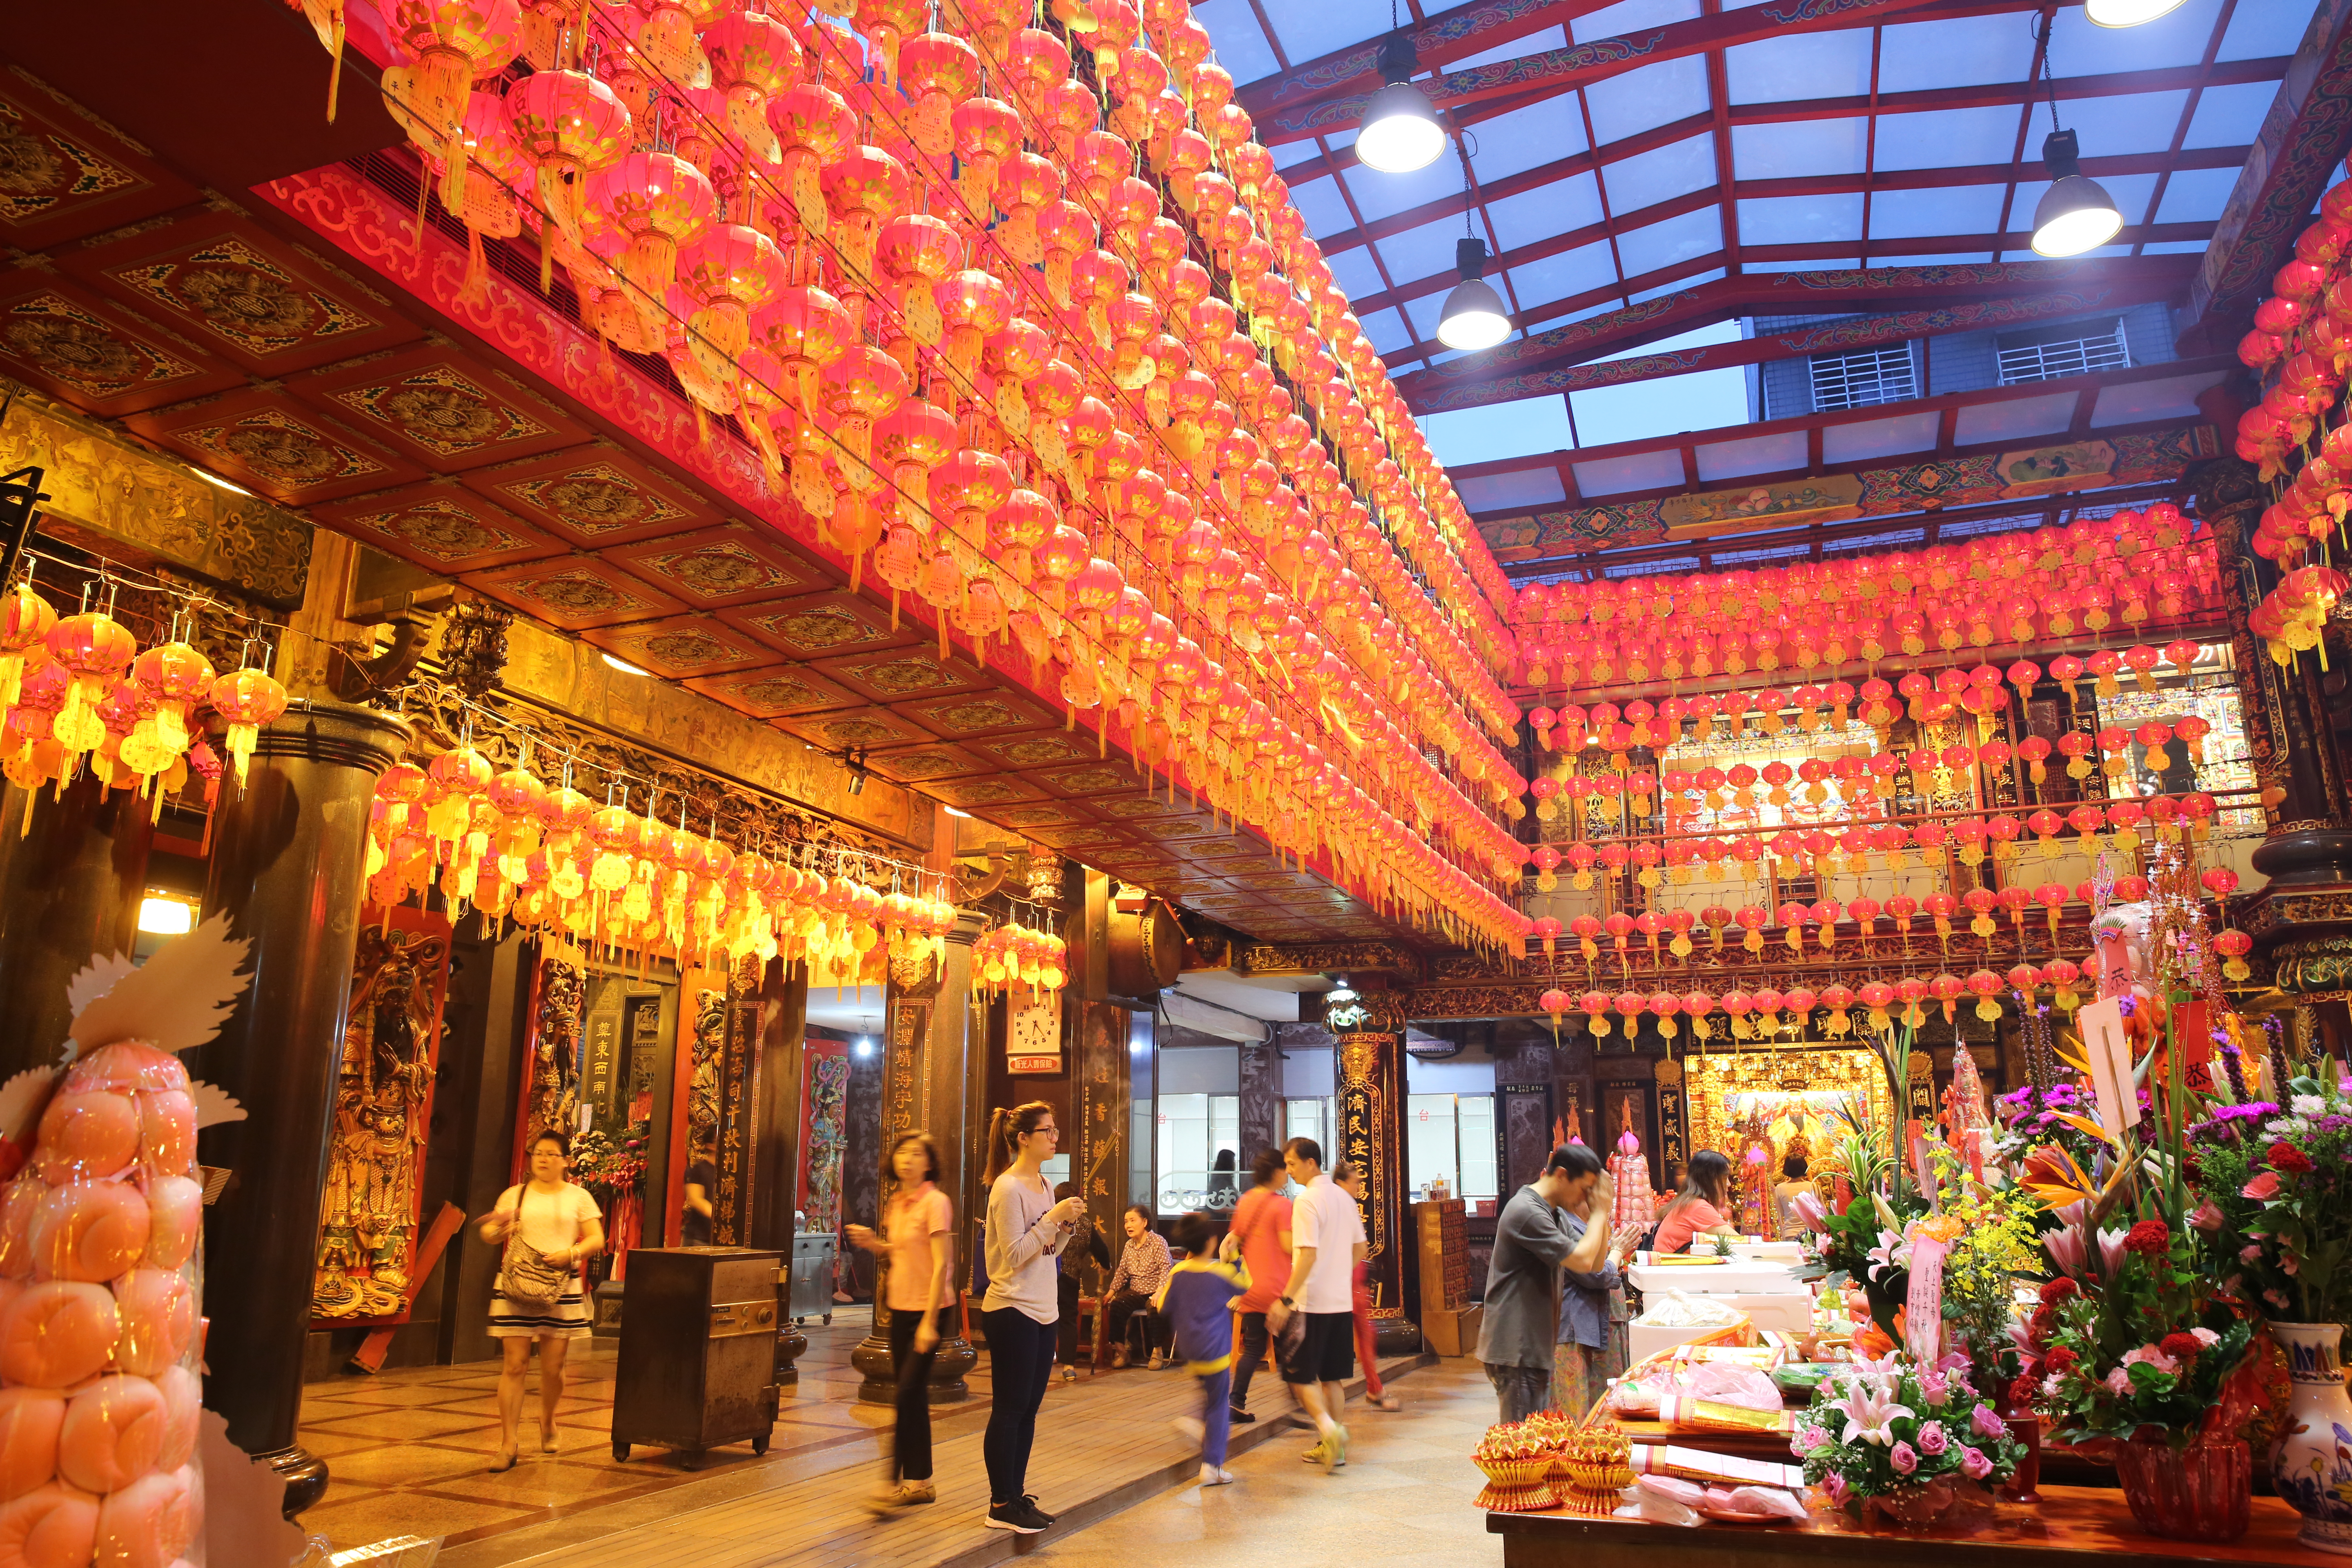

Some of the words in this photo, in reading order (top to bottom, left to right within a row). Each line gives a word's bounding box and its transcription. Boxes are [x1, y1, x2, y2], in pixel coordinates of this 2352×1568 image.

[645, 33, 654, 53] 平安
[731, 109, 739, 127] 平安
[879, 554, 886, 570] 平安
[912, 563, 919, 579] 合家
[954, 607, 962, 622] 平安
[2110, 967, 2128, 991] 恭
[1014, 1059, 1052, 1069] 新光人壽保險
[892, 1007, 915, 1140] 安瀾靖海宇功
[1419, 1109, 1429, 1121] 台
[1090, 1029, 1109, 1269] 萬姓香報大
